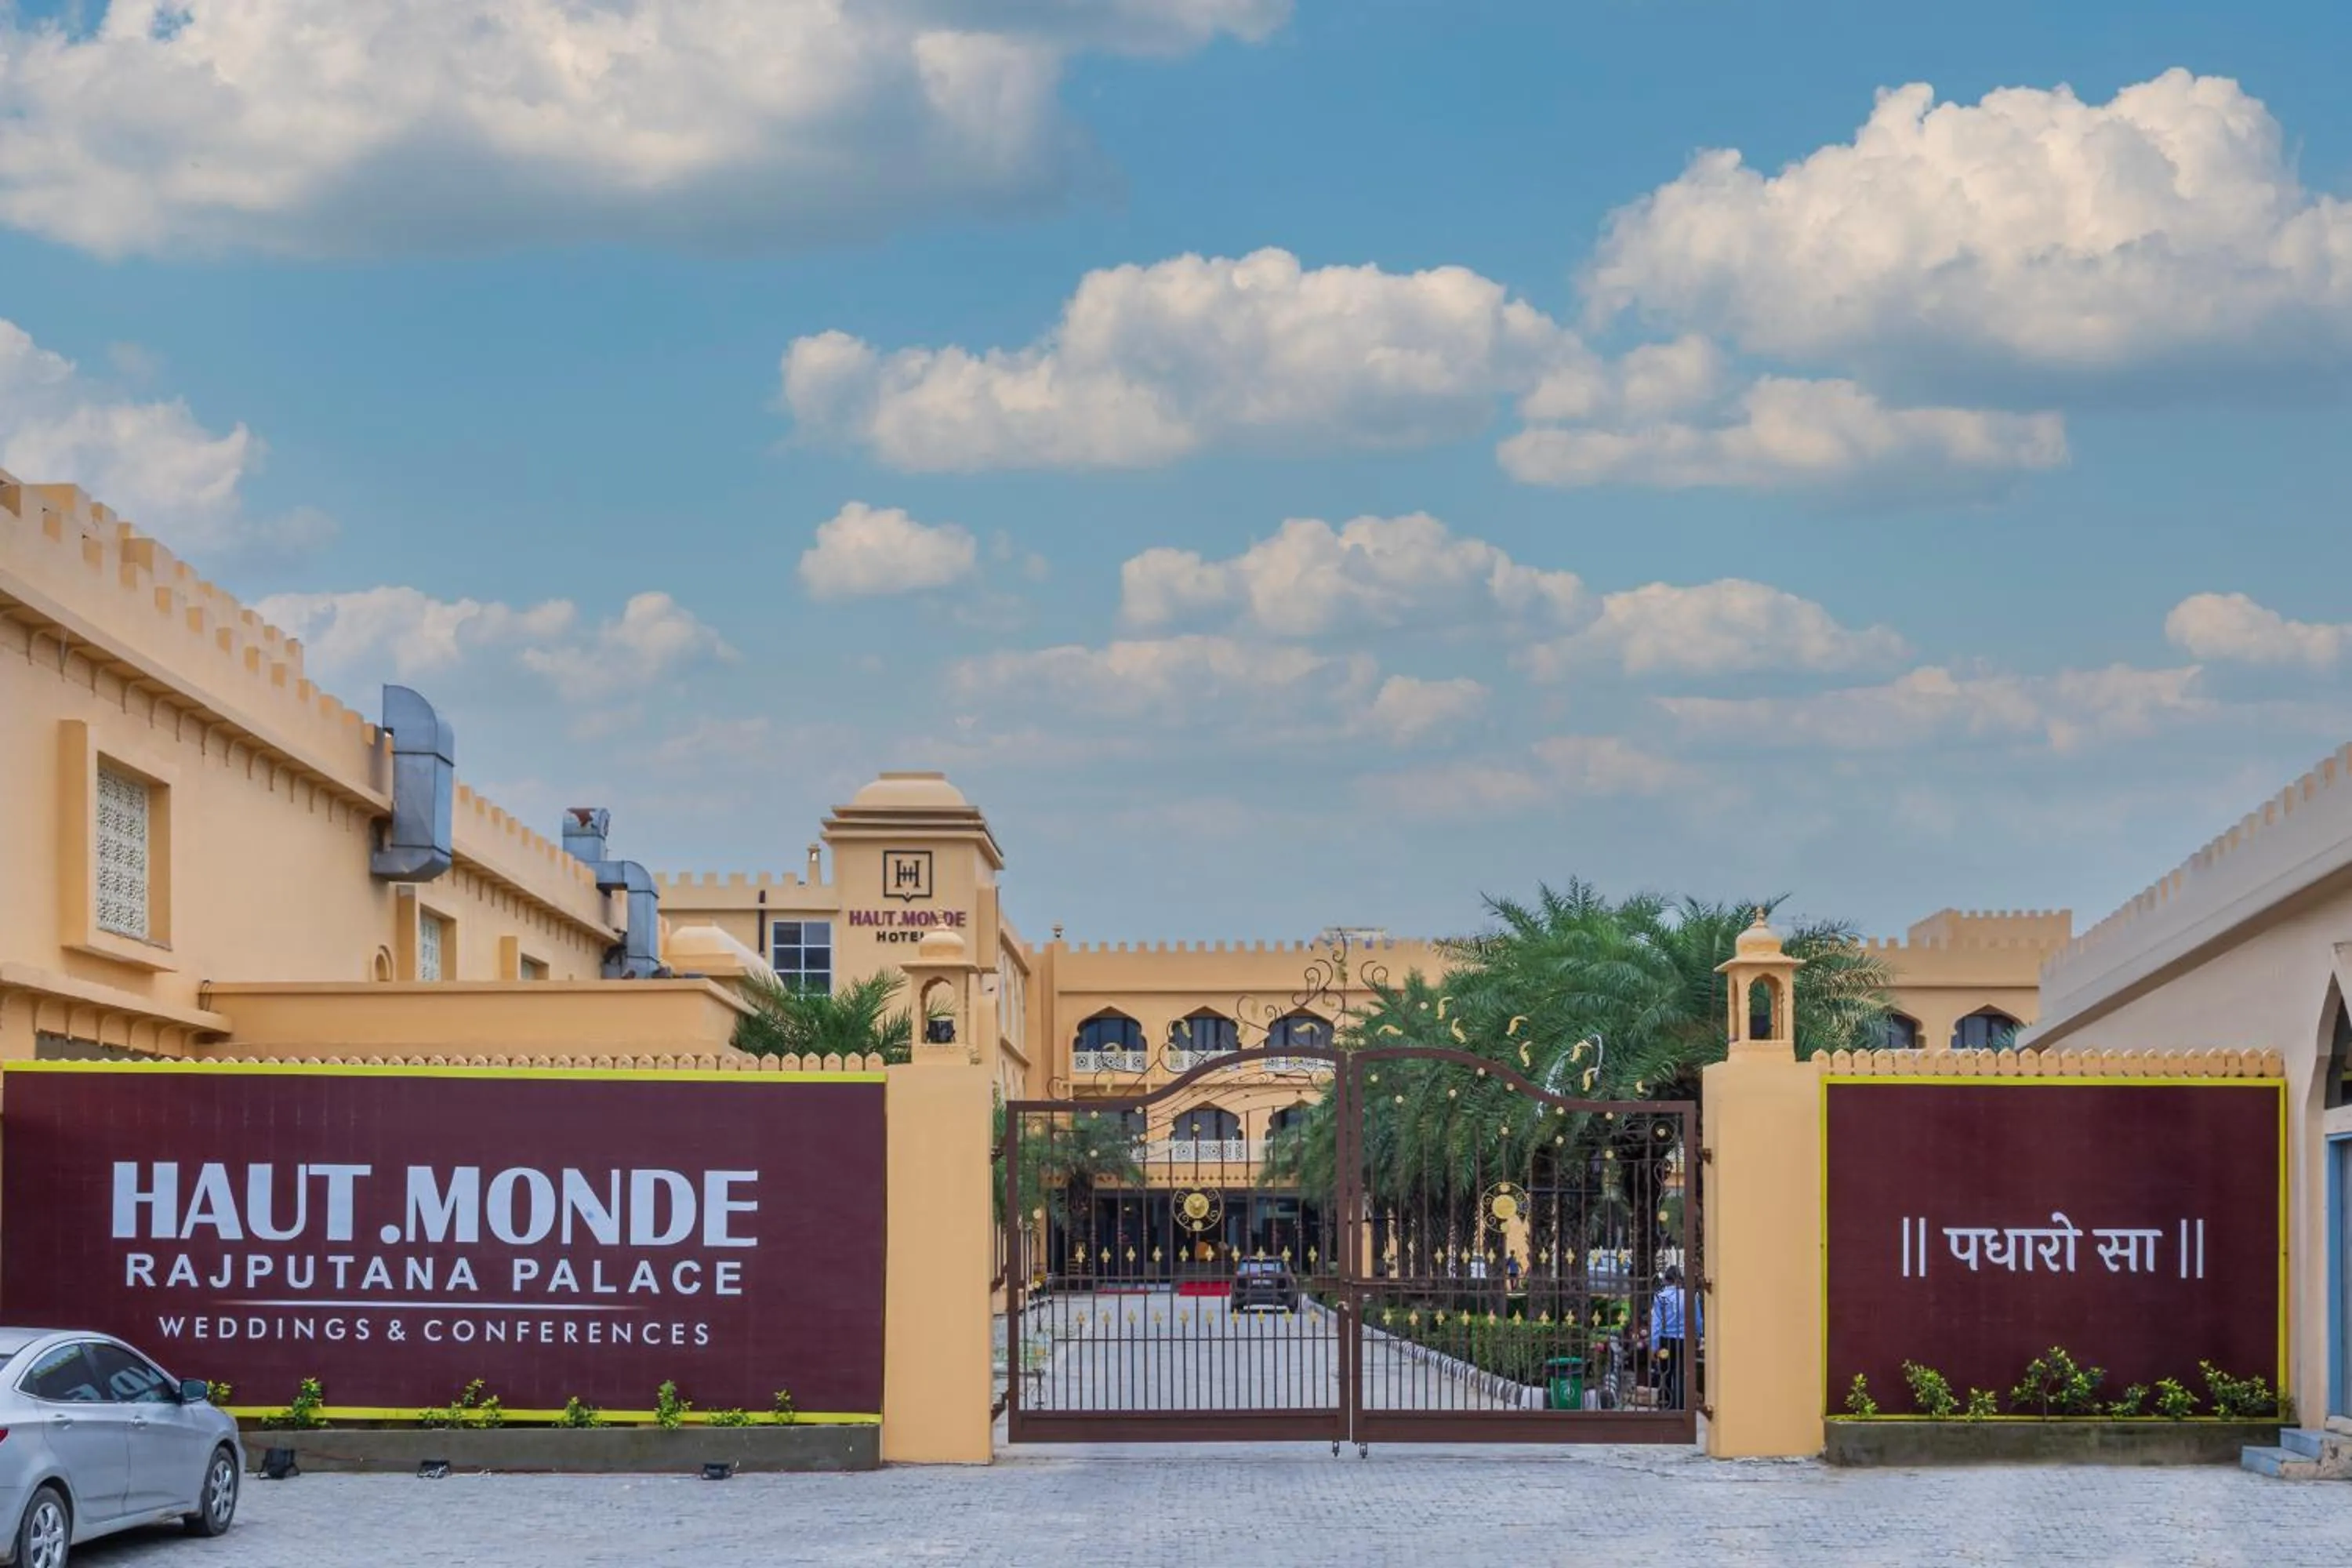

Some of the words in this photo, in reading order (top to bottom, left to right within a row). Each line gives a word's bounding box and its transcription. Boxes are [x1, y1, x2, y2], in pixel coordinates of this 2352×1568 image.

[111, 1161, 759, 1248] HAUT.MONDE
[1942, 1211, 2083, 1272] पधारो
[2092, 1228, 2163, 1272] सा
[125, 1253, 478, 1291] RAJPUTANA
[512, 1258, 743, 1295] PALACE
[158, 1316, 370, 1341] WEDDINGS
[387, 1319, 406, 1341] &
[423, 1319, 709, 1345] CONFERENCES
